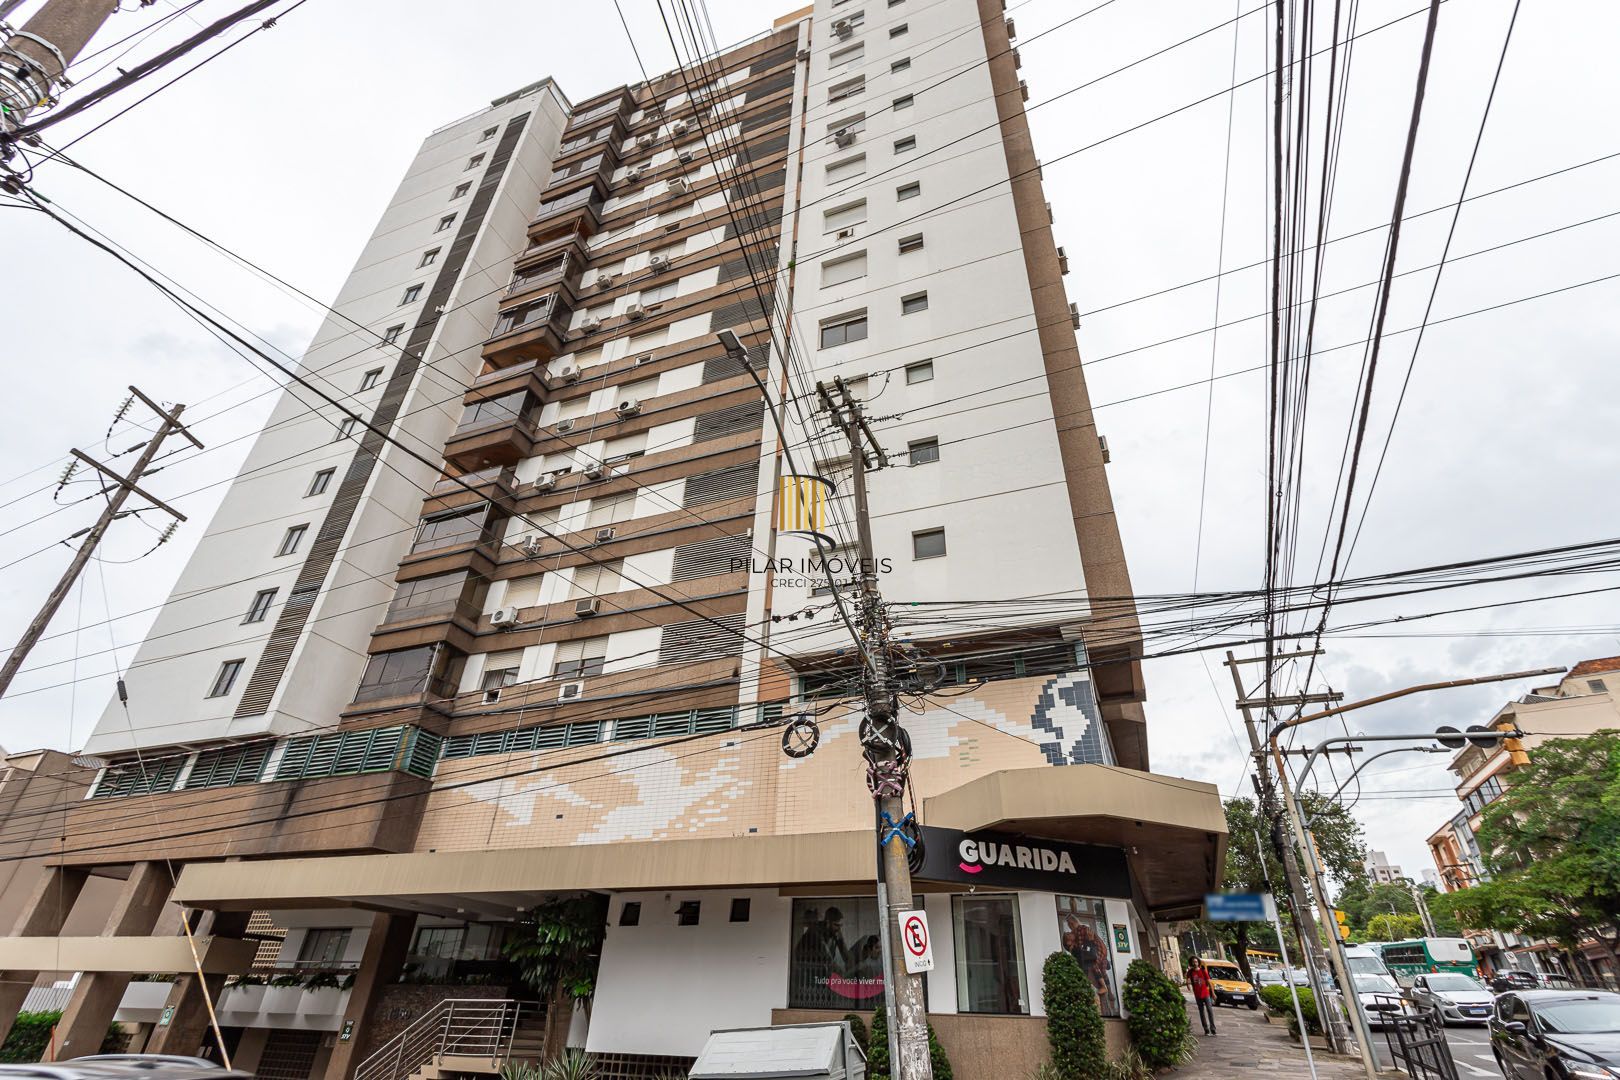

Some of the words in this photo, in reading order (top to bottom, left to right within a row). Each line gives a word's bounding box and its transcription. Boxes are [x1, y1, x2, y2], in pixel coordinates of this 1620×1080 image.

[958, 839, 1077, 874] GUARIDA
[814, 976, 829, 984] Tudo
[830, 978, 842, 986] pra
[842, 976, 858, 985] você
[859, 976, 876, 985] viver
